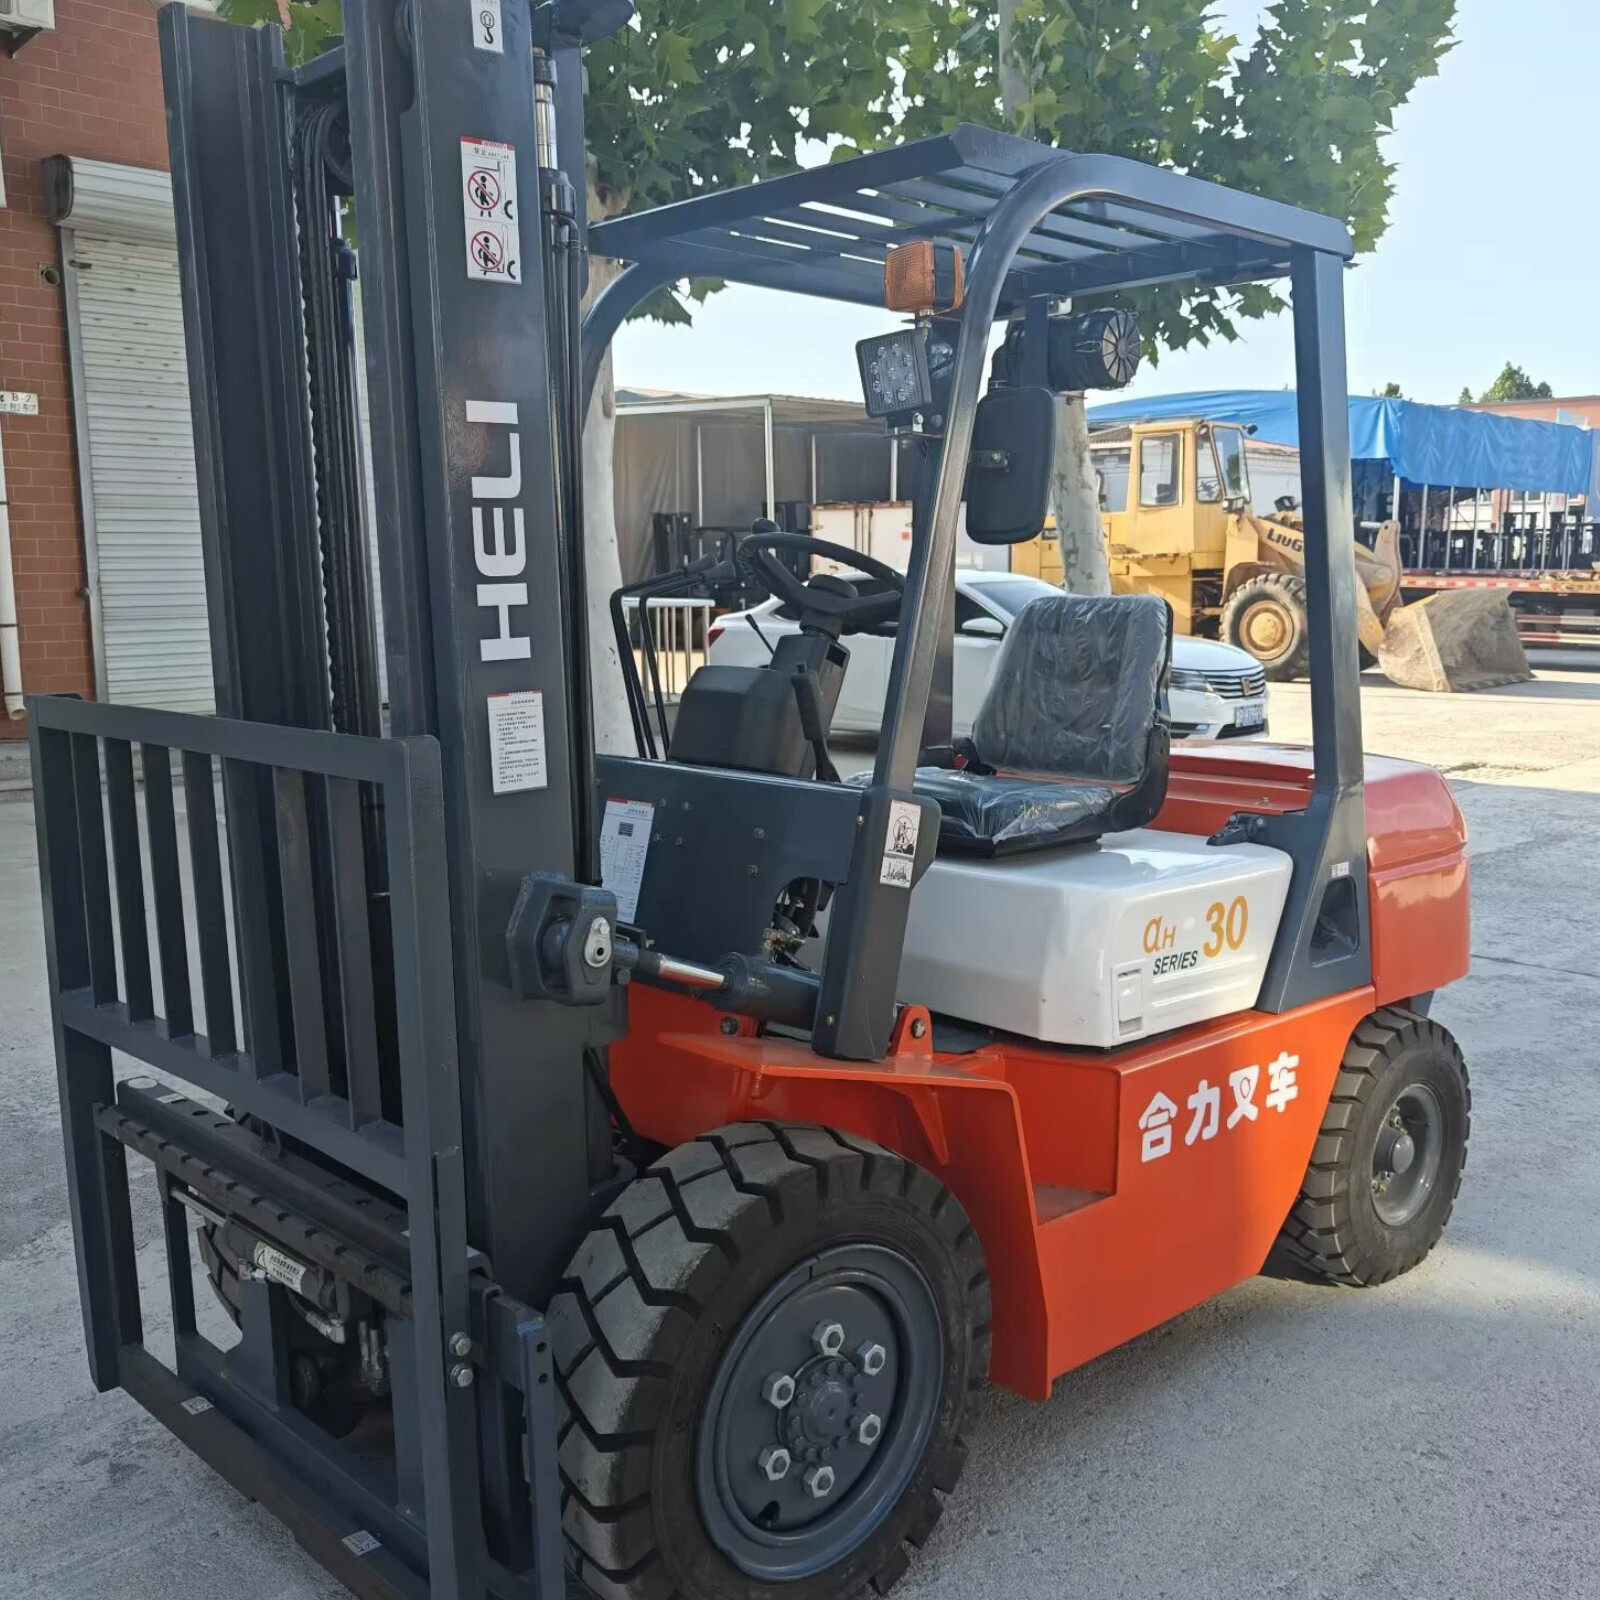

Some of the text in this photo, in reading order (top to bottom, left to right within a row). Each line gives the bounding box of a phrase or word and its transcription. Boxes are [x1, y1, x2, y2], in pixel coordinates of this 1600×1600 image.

[466, 400, 532, 662] HELI
[1152, 950, 1199, 976] SERIES
[1203, 895, 1249, 958] 30
[1138, 1050, 1300, 1164] 合力叉车
